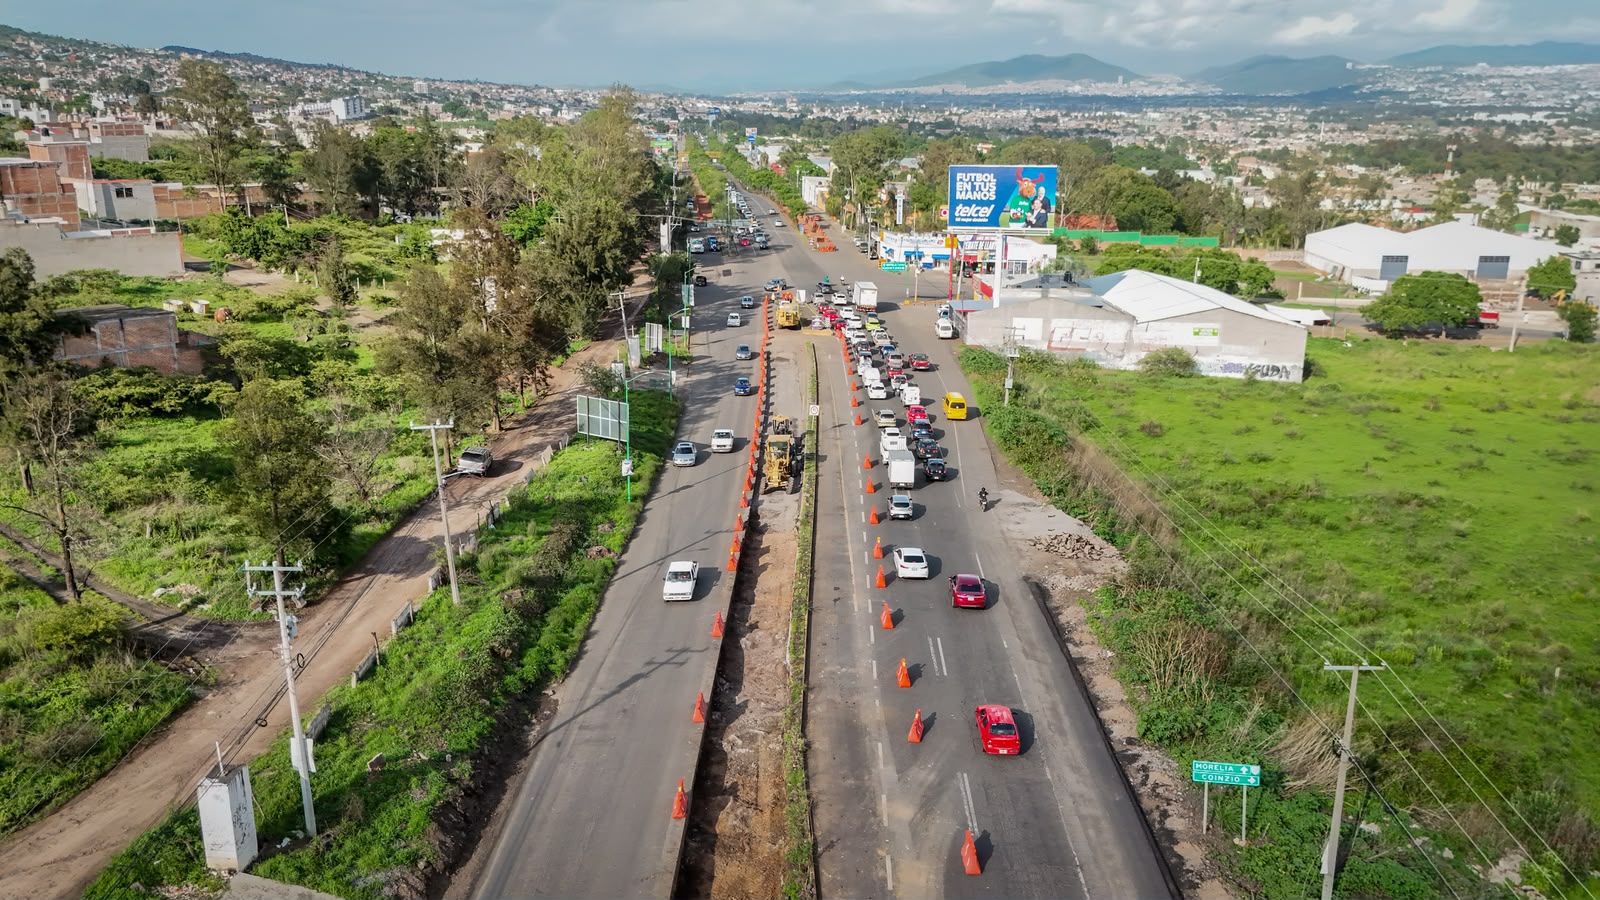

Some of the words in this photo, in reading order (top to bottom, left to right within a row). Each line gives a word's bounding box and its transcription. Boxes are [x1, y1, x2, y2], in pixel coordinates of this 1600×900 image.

[956, 173, 997, 182] FUTBOL
[956, 182, 974, 191] EN
[976, 182, 997, 191] TUS
[956, 191, 996, 200] MANOS
[954, 204, 995, 218] telcel
[1195, 763, 1234, 771] MORELIA
[1201, 774, 1240, 782] COINZIO
